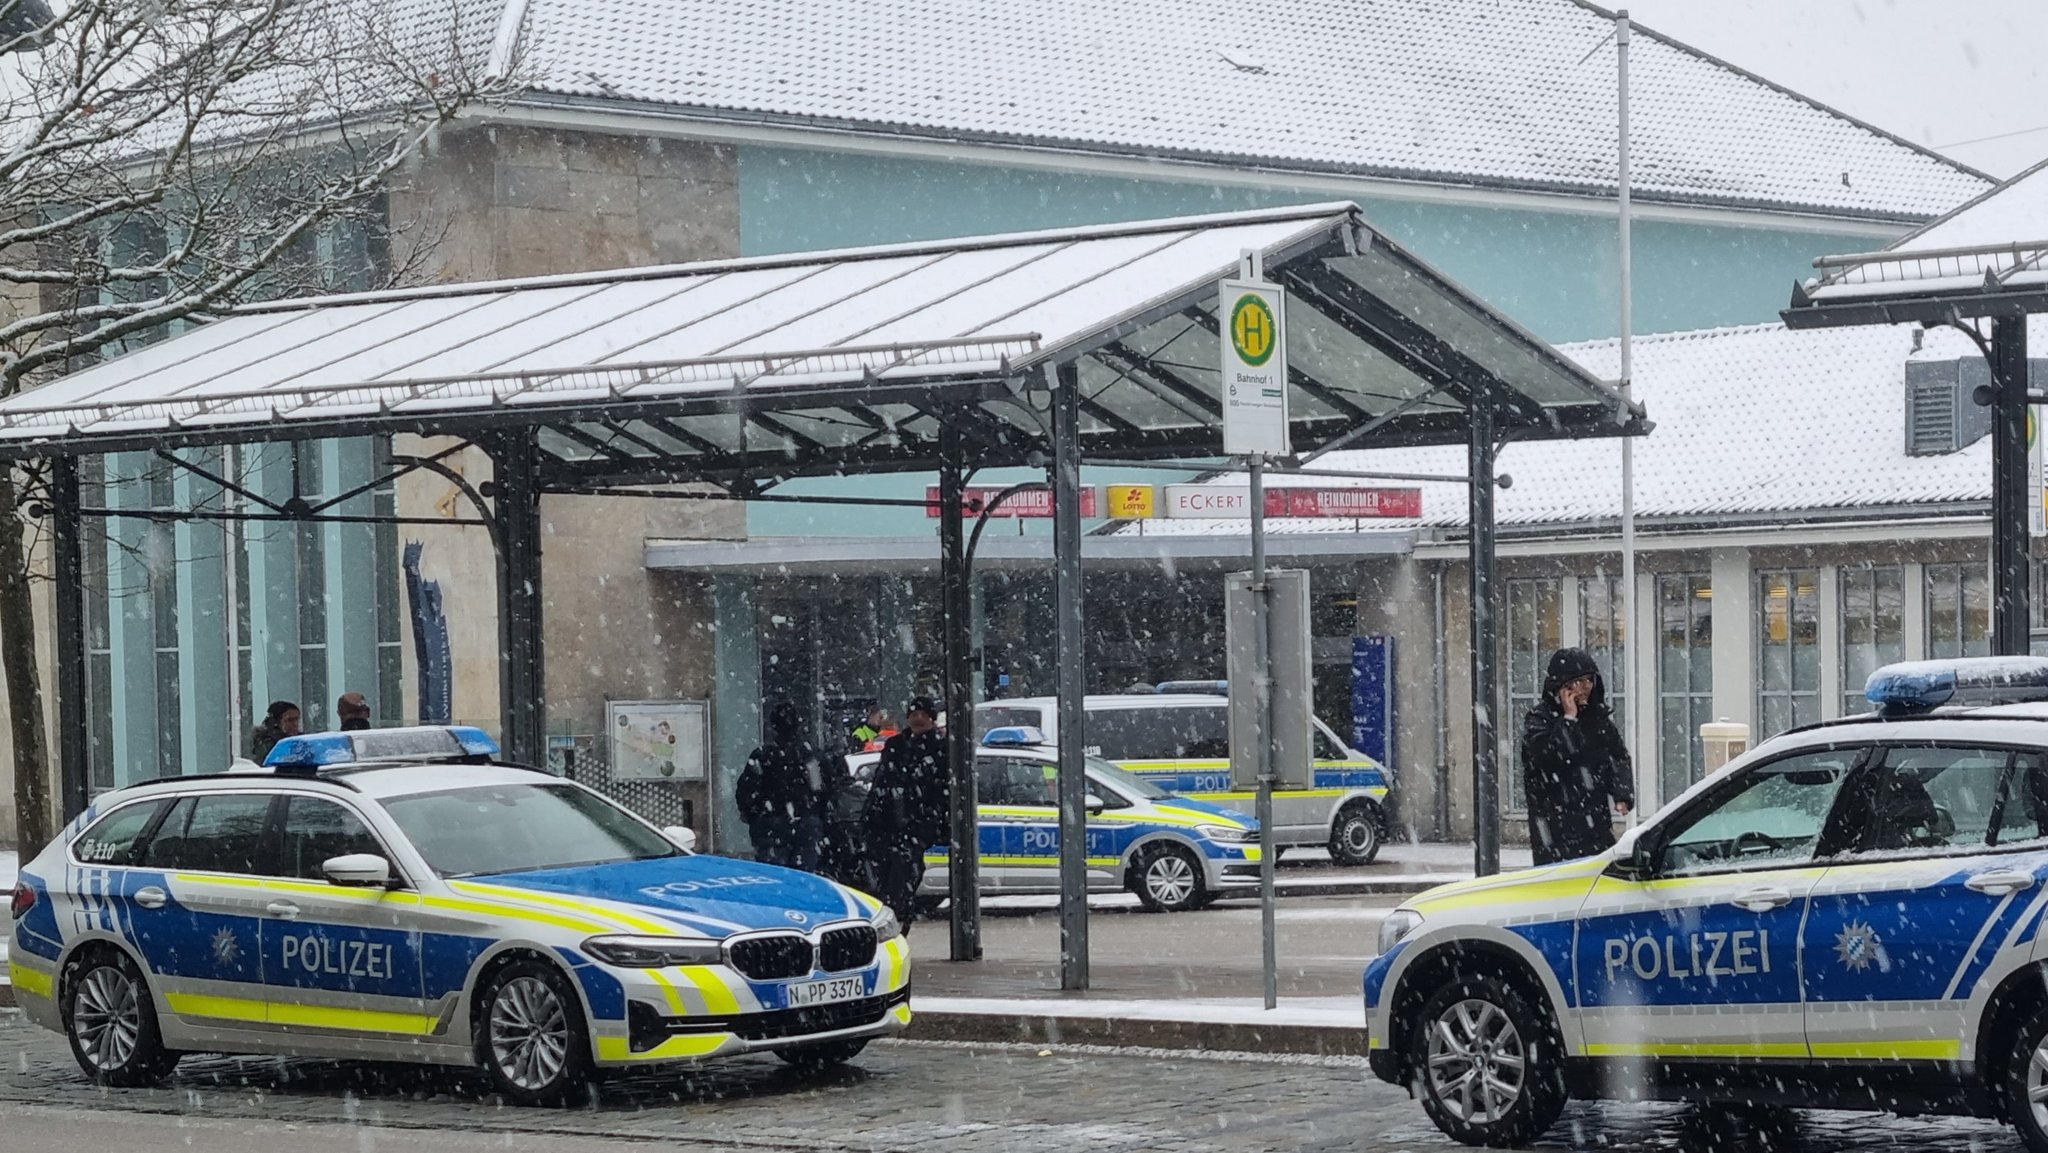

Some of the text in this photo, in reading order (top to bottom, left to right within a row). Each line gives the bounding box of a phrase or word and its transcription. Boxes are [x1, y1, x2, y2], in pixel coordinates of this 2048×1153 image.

[1246, 252, 1254, 278] 1
[1243, 310, 1263, 350] H
[1236, 373, 1268, 384] Bahnhof
[983, 490, 1049, 508] REKOMMEN
[1123, 503, 1146, 511] LOTTO
[1180, 494, 1244, 510] ECKERT
[1317, 491, 1379, 508] REINKOMMEN
[1023, 831, 1097, 849] POLI
[93, 842, 116, 860] 110
[638, 875, 783, 897] POLIZEI
[282, 935, 393, 979] POLIZEI
[1605, 929, 1771, 983] POLIZEI
[789, 978, 862, 1005] N PP 3376
